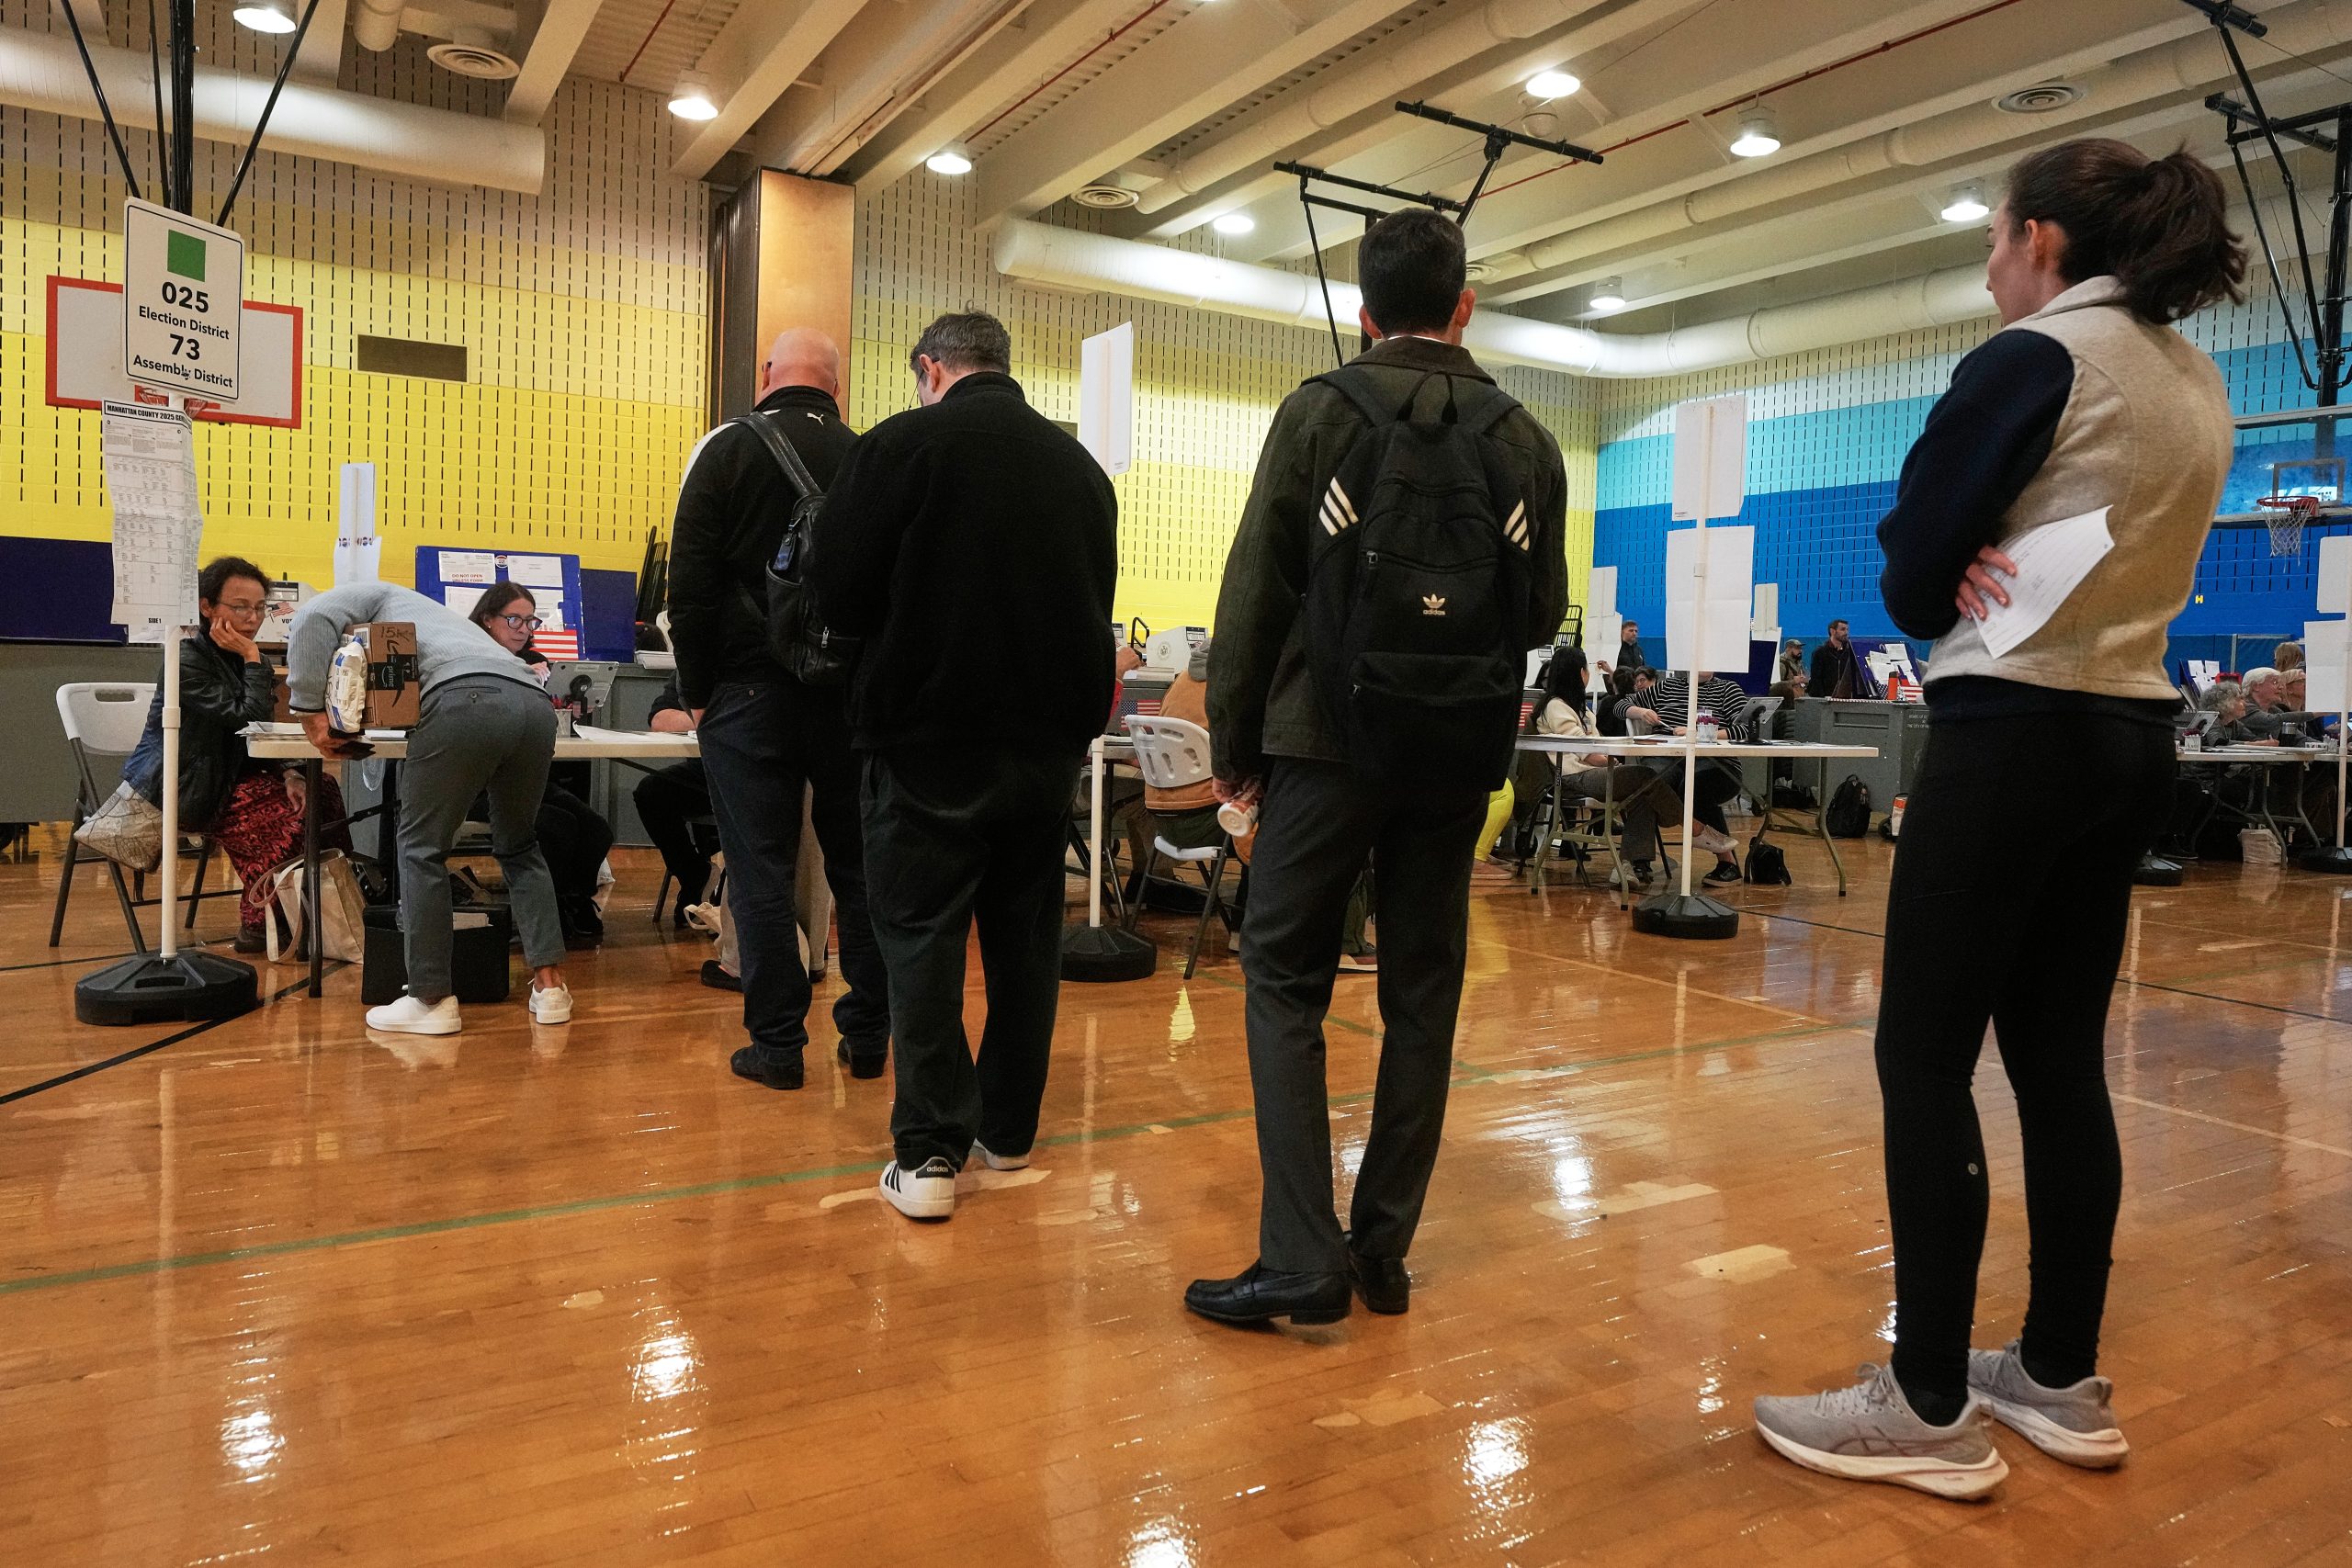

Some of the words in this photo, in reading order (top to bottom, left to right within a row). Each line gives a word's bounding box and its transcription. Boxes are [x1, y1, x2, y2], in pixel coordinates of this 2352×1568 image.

[162, 281, 209, 313] 025
[139, 305, 187, 329] Election
[189, 319, 230, 340] District
[169, 333, 200, 361] 73
[133, 355, 191, 380] Assembly
[194, 368, 233, 388] District
[107, 404, 137, 415] MANHATTAN
[137, 409, 159, 419] COUNTY
